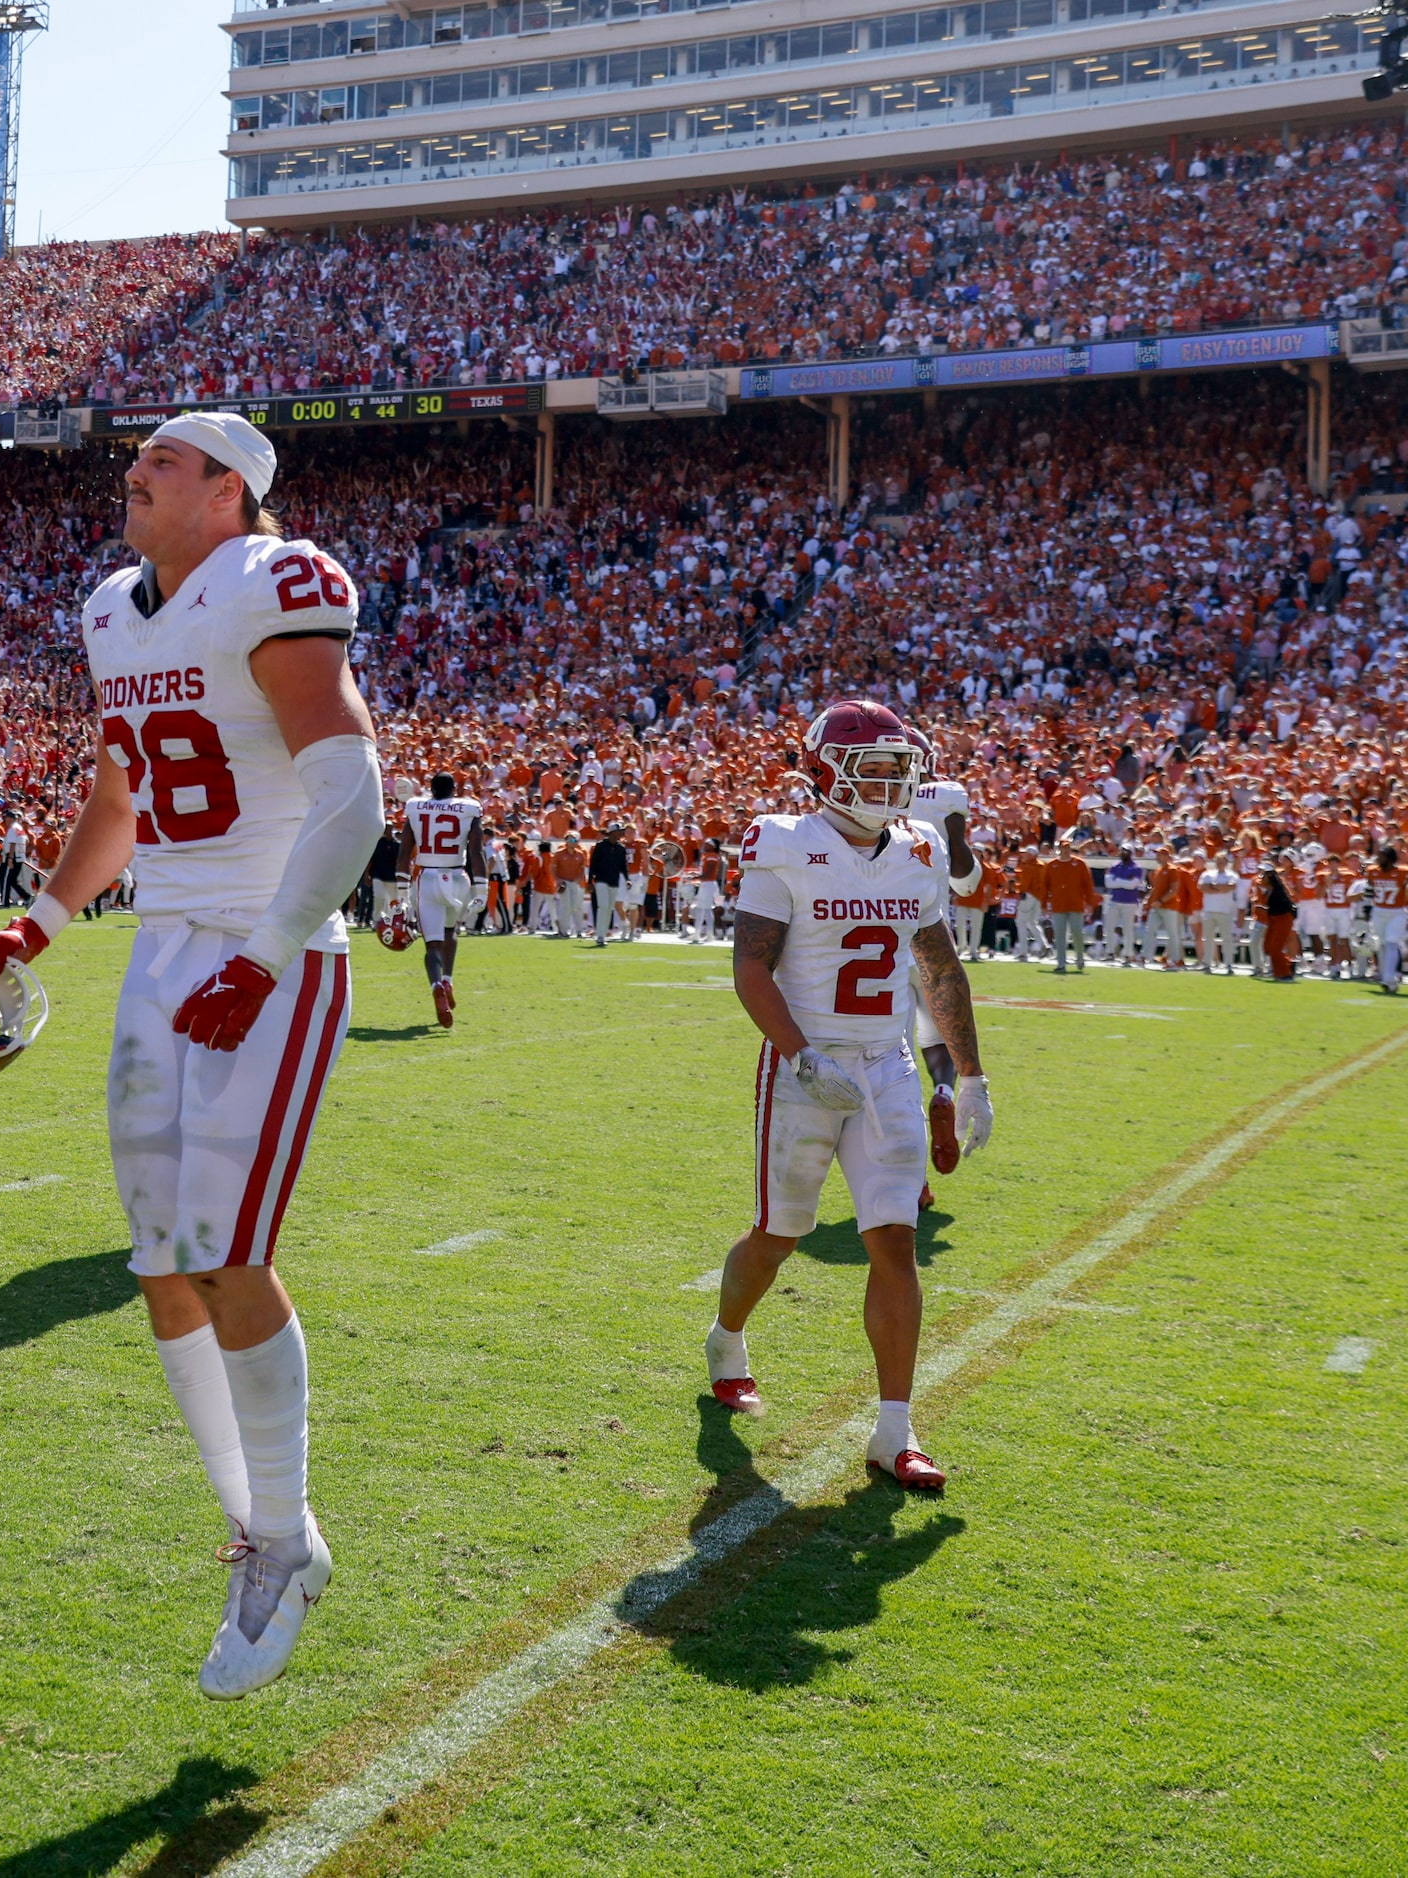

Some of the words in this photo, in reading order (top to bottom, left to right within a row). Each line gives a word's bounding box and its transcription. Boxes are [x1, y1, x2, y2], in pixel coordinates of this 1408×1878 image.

[1181, 343, 1222, 362] EASY
[1226, 341, 1247, 358] TO
[1251, 334, 1304, 356] ENJOY
[791, 373, 825, 390] EASY
[828, 371, 848, 388] TO
[850, 366, 895, 385] ENJOY
[953, 360, 995, 378] ENJOY
[292, 401, 336, 421] 0:00
[376, 404, 396, 418] 44
[416, 396, 442, 414] 30
[469, 396, 504, 408] TEXAS
[112, 413, 168, 426] OKLAHOMA
[248, 411, 267, 424] 10
[350, 406, 361, 419] 4
[271, 554, 349, 612] 28
[102, 667, 205, 709] OONERS
[416, 801, 465, 814] LAWRENCE
[419, 813, 461, 855] 12
[741, 825, 761, 861] 2
[813, 899, 920, 920] SOONERS
[834, 926, 898, 1015] 2
